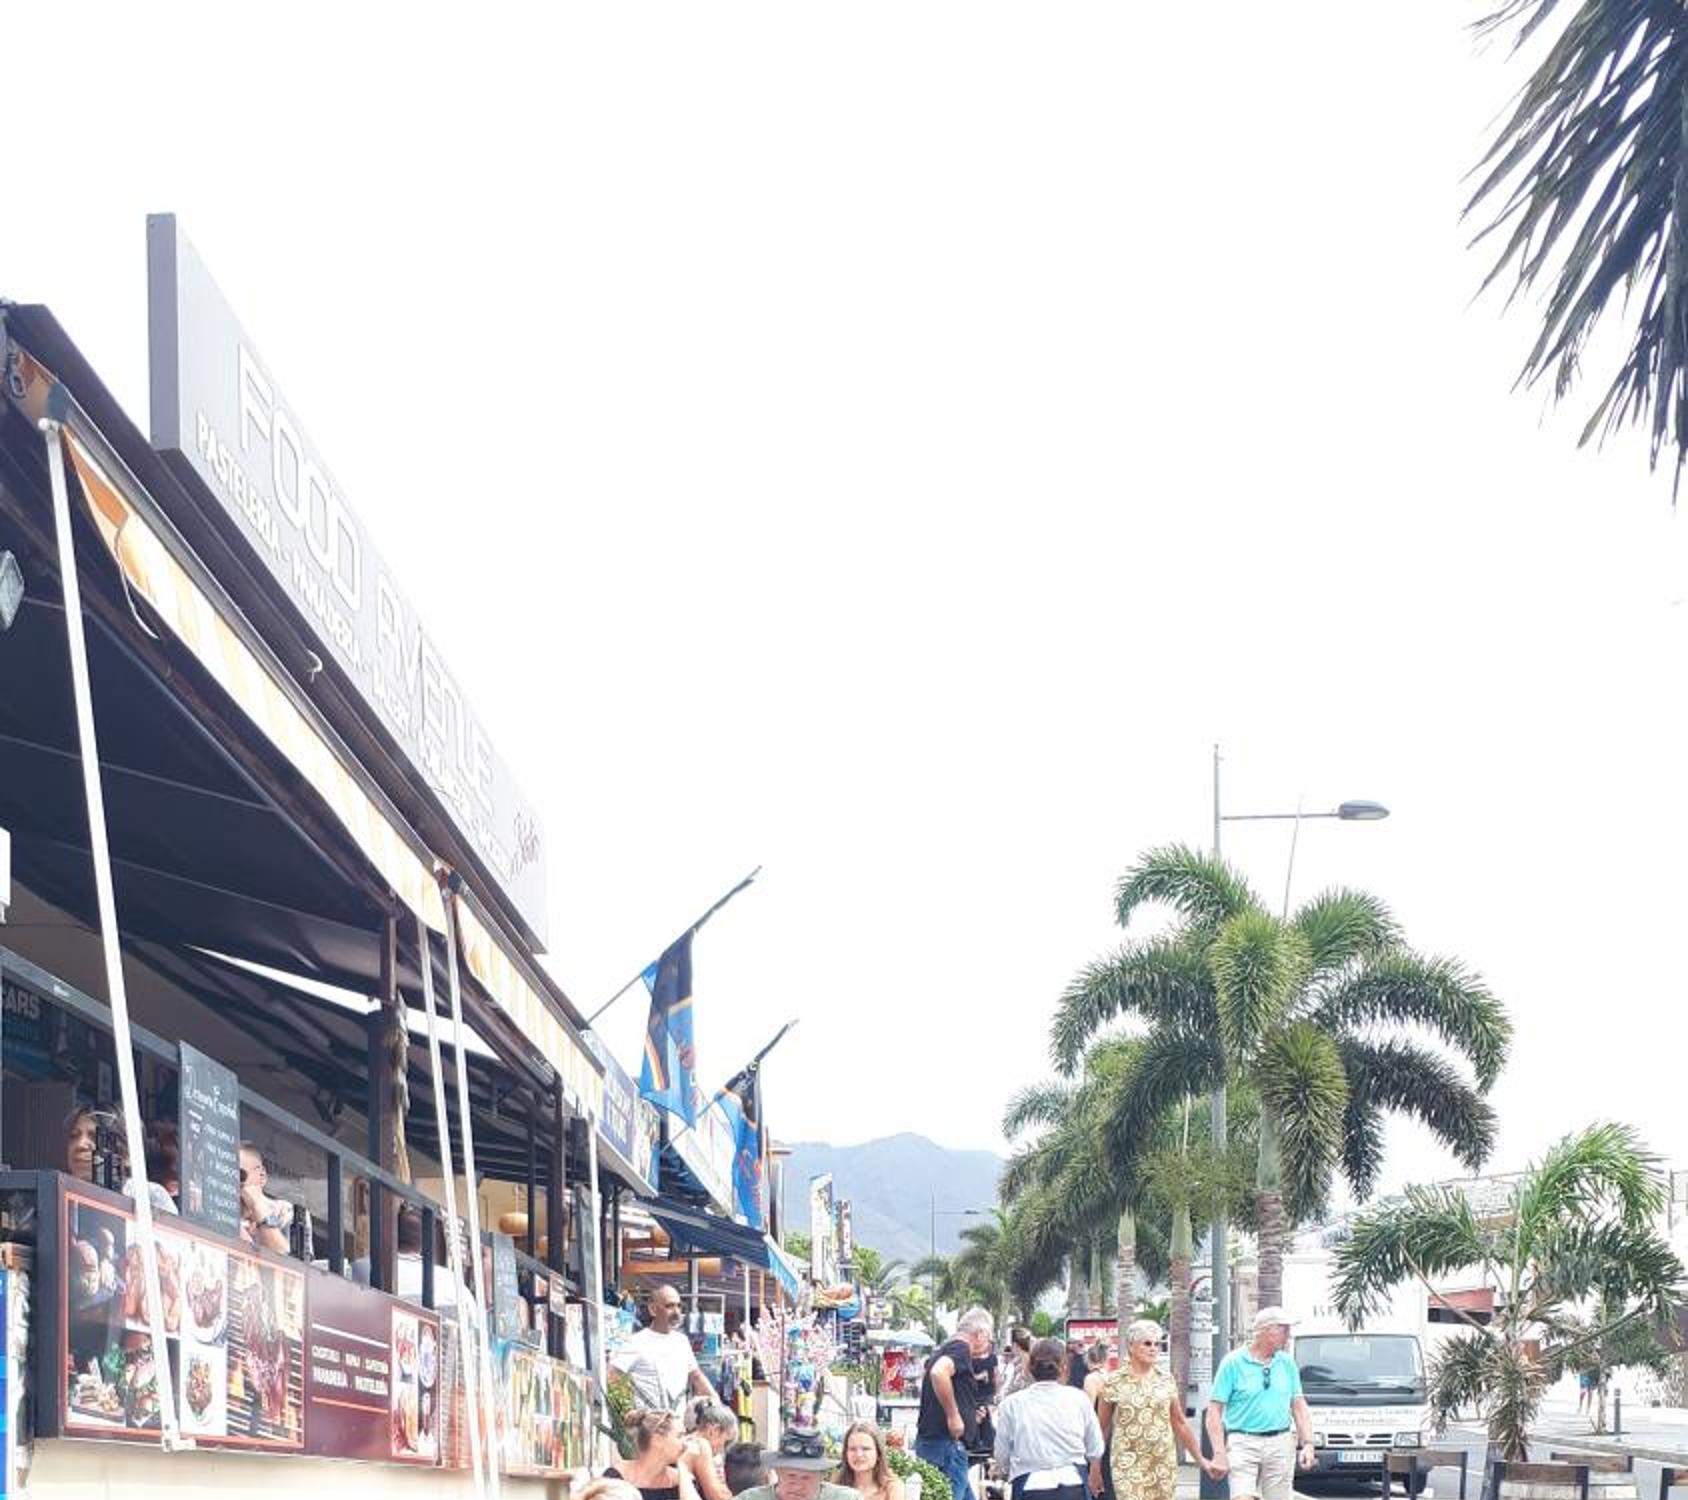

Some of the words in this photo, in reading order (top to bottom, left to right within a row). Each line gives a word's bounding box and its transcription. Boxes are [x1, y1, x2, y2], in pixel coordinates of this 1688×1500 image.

[238, 343, 362, 610] FOOD
[376, 570, 496, 816] AVENUE
[2, 986, 41, 1020] ARS
